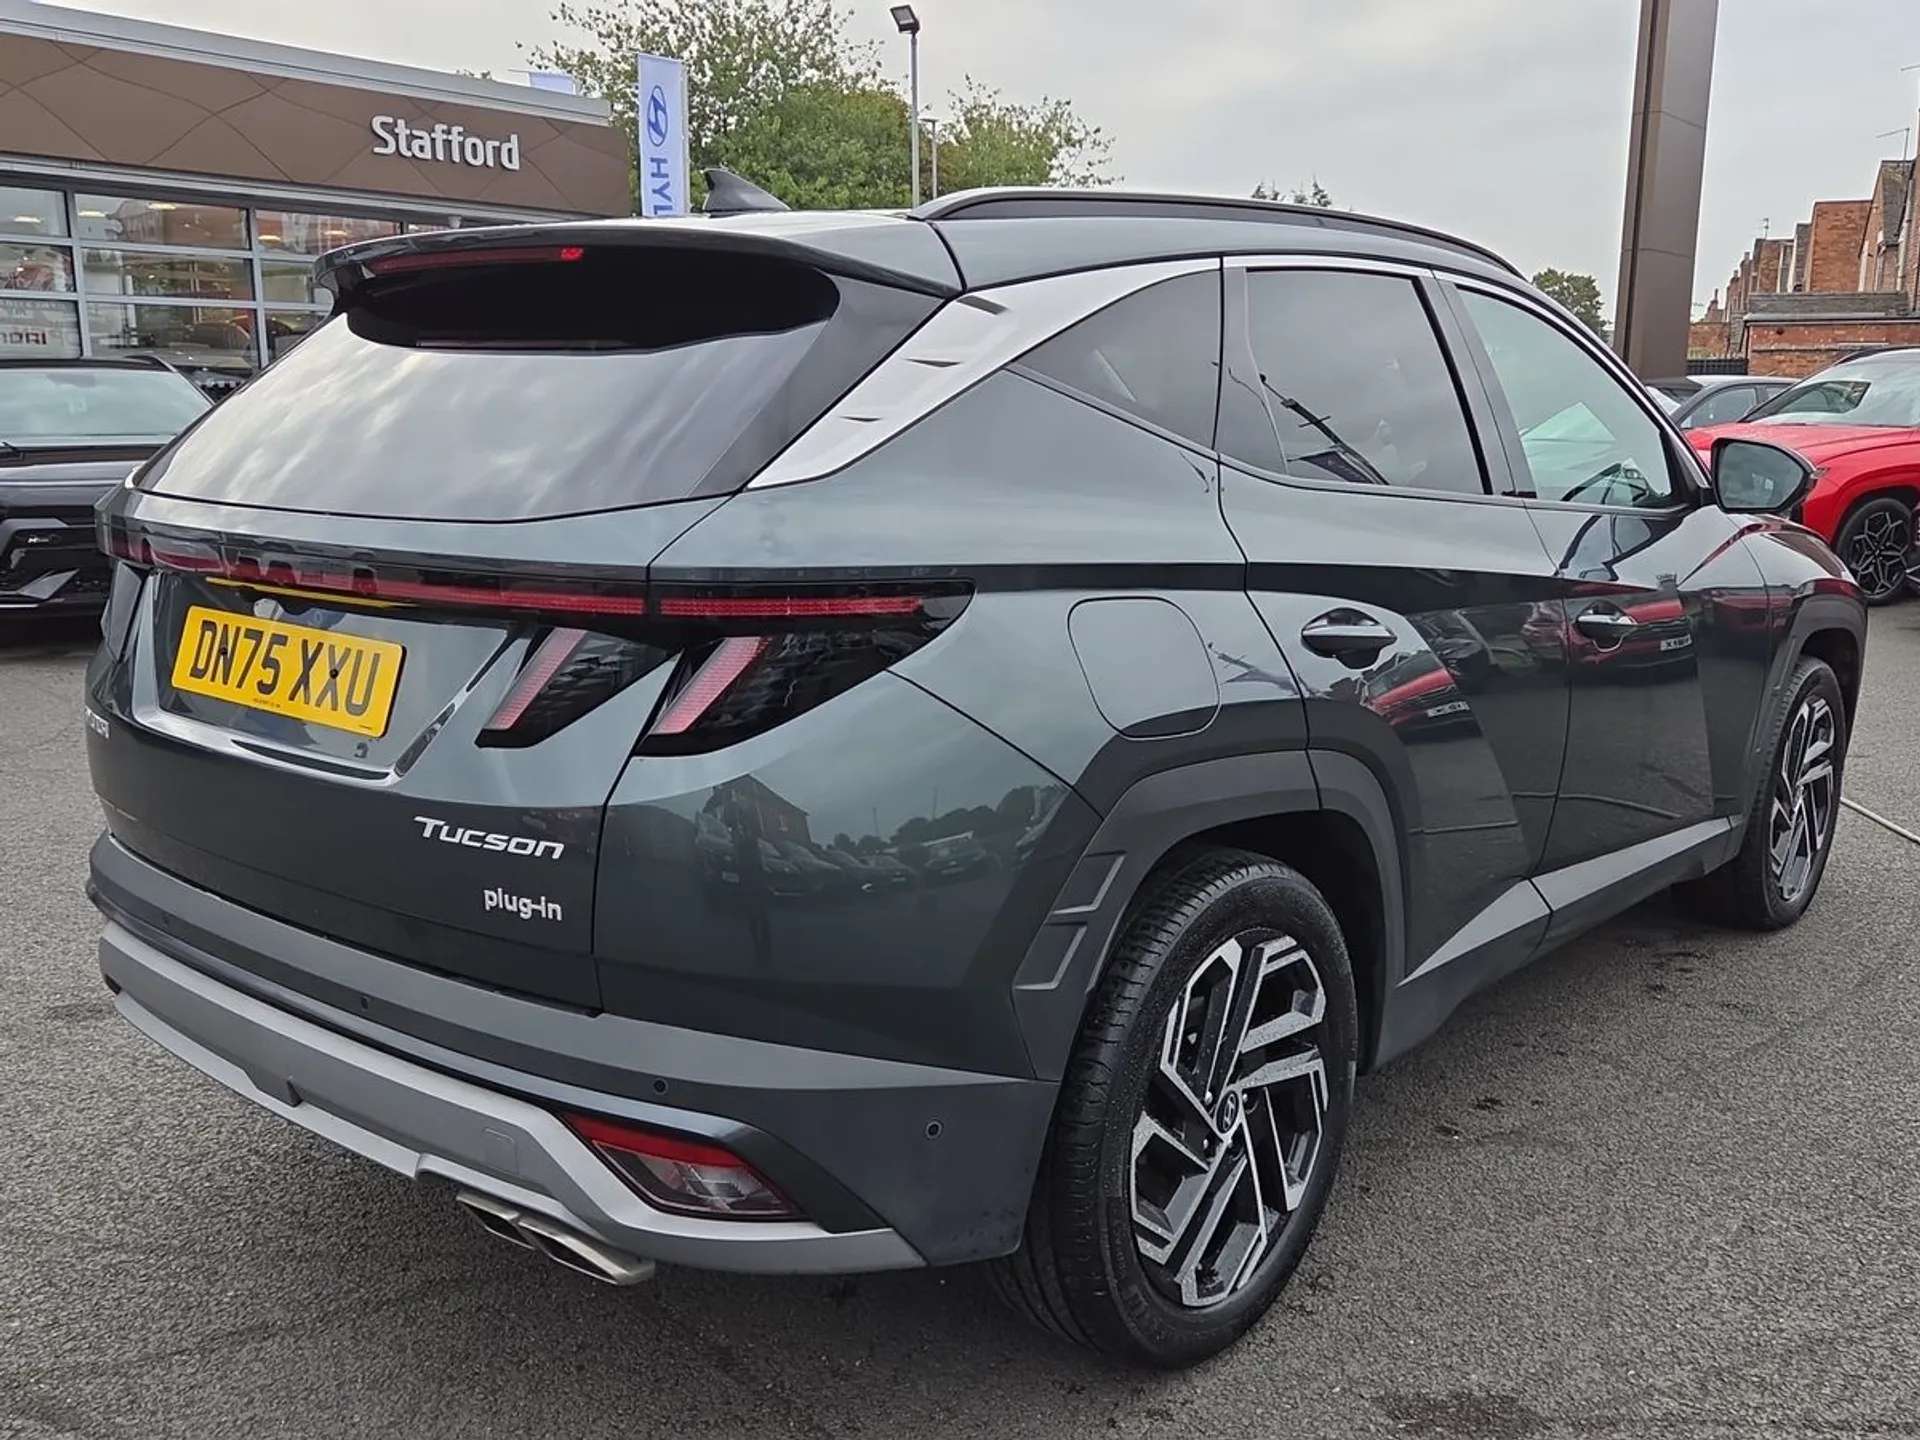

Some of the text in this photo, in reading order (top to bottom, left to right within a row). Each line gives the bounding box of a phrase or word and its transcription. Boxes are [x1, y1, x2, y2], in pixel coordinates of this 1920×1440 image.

[371, 115, 520, 171] Stafford
[189, 619, 381, 717] DN75 XXU
[483, 887, 562, 921] plug-in
